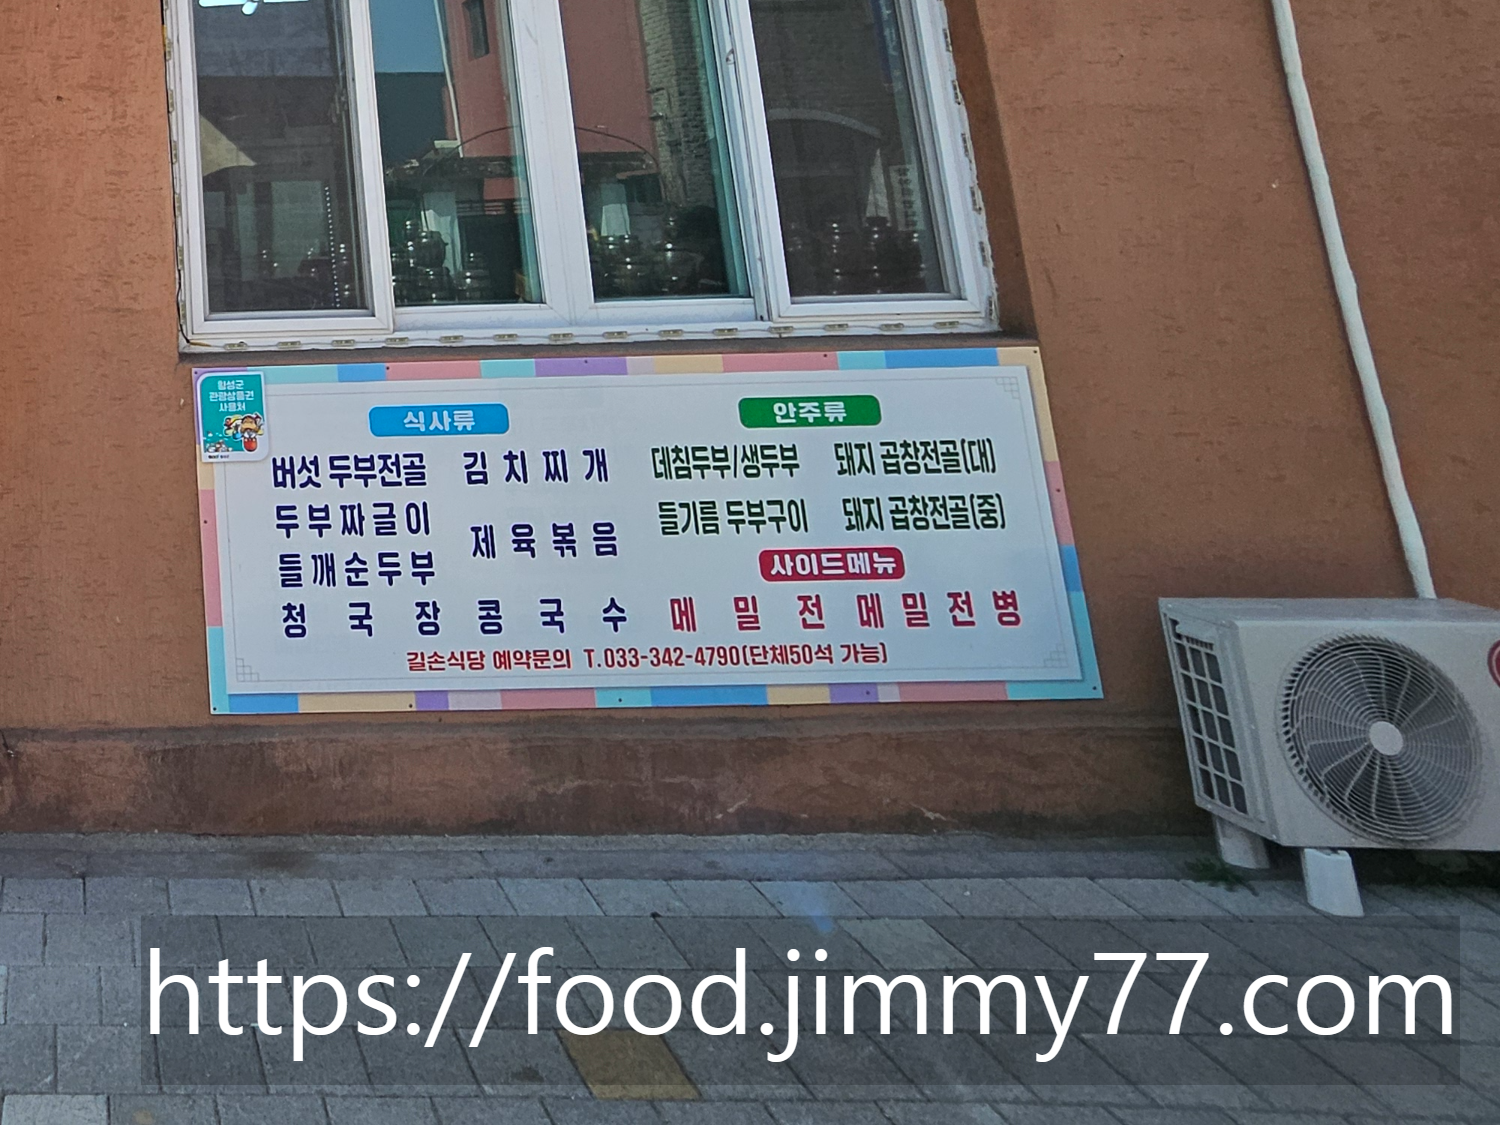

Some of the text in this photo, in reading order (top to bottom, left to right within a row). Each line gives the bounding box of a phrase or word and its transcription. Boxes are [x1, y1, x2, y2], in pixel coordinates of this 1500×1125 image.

[403, 409, 477, 432] 식사류
[772, 400, 848, 424] 안주류
[271, 452, 428, 489] 버섯 두부전골
[462, 447, 610, 485] 김치찌개
[651, 443, 801, 480] 데침두부/생두부
[833, 437, 998, 477] 돼지 곱창전골(대)
[275, 501, 431, 539] 두부짜글이
[658, 498, 809, 536] 들기름 두부구이
[842, 493, 1007, 532] 돼지 곱창전골(중)
[470, 520, 619, 560] 제육볶음
[278, 550, 436, 589] 들깨순두부
[770, 551, 898, 577] 사이드메뉴
[406, 650, 486, 672] 길손식당
[492, 648, 572, 671] 예약문의
[840, 641, 889, 665] 가능)
